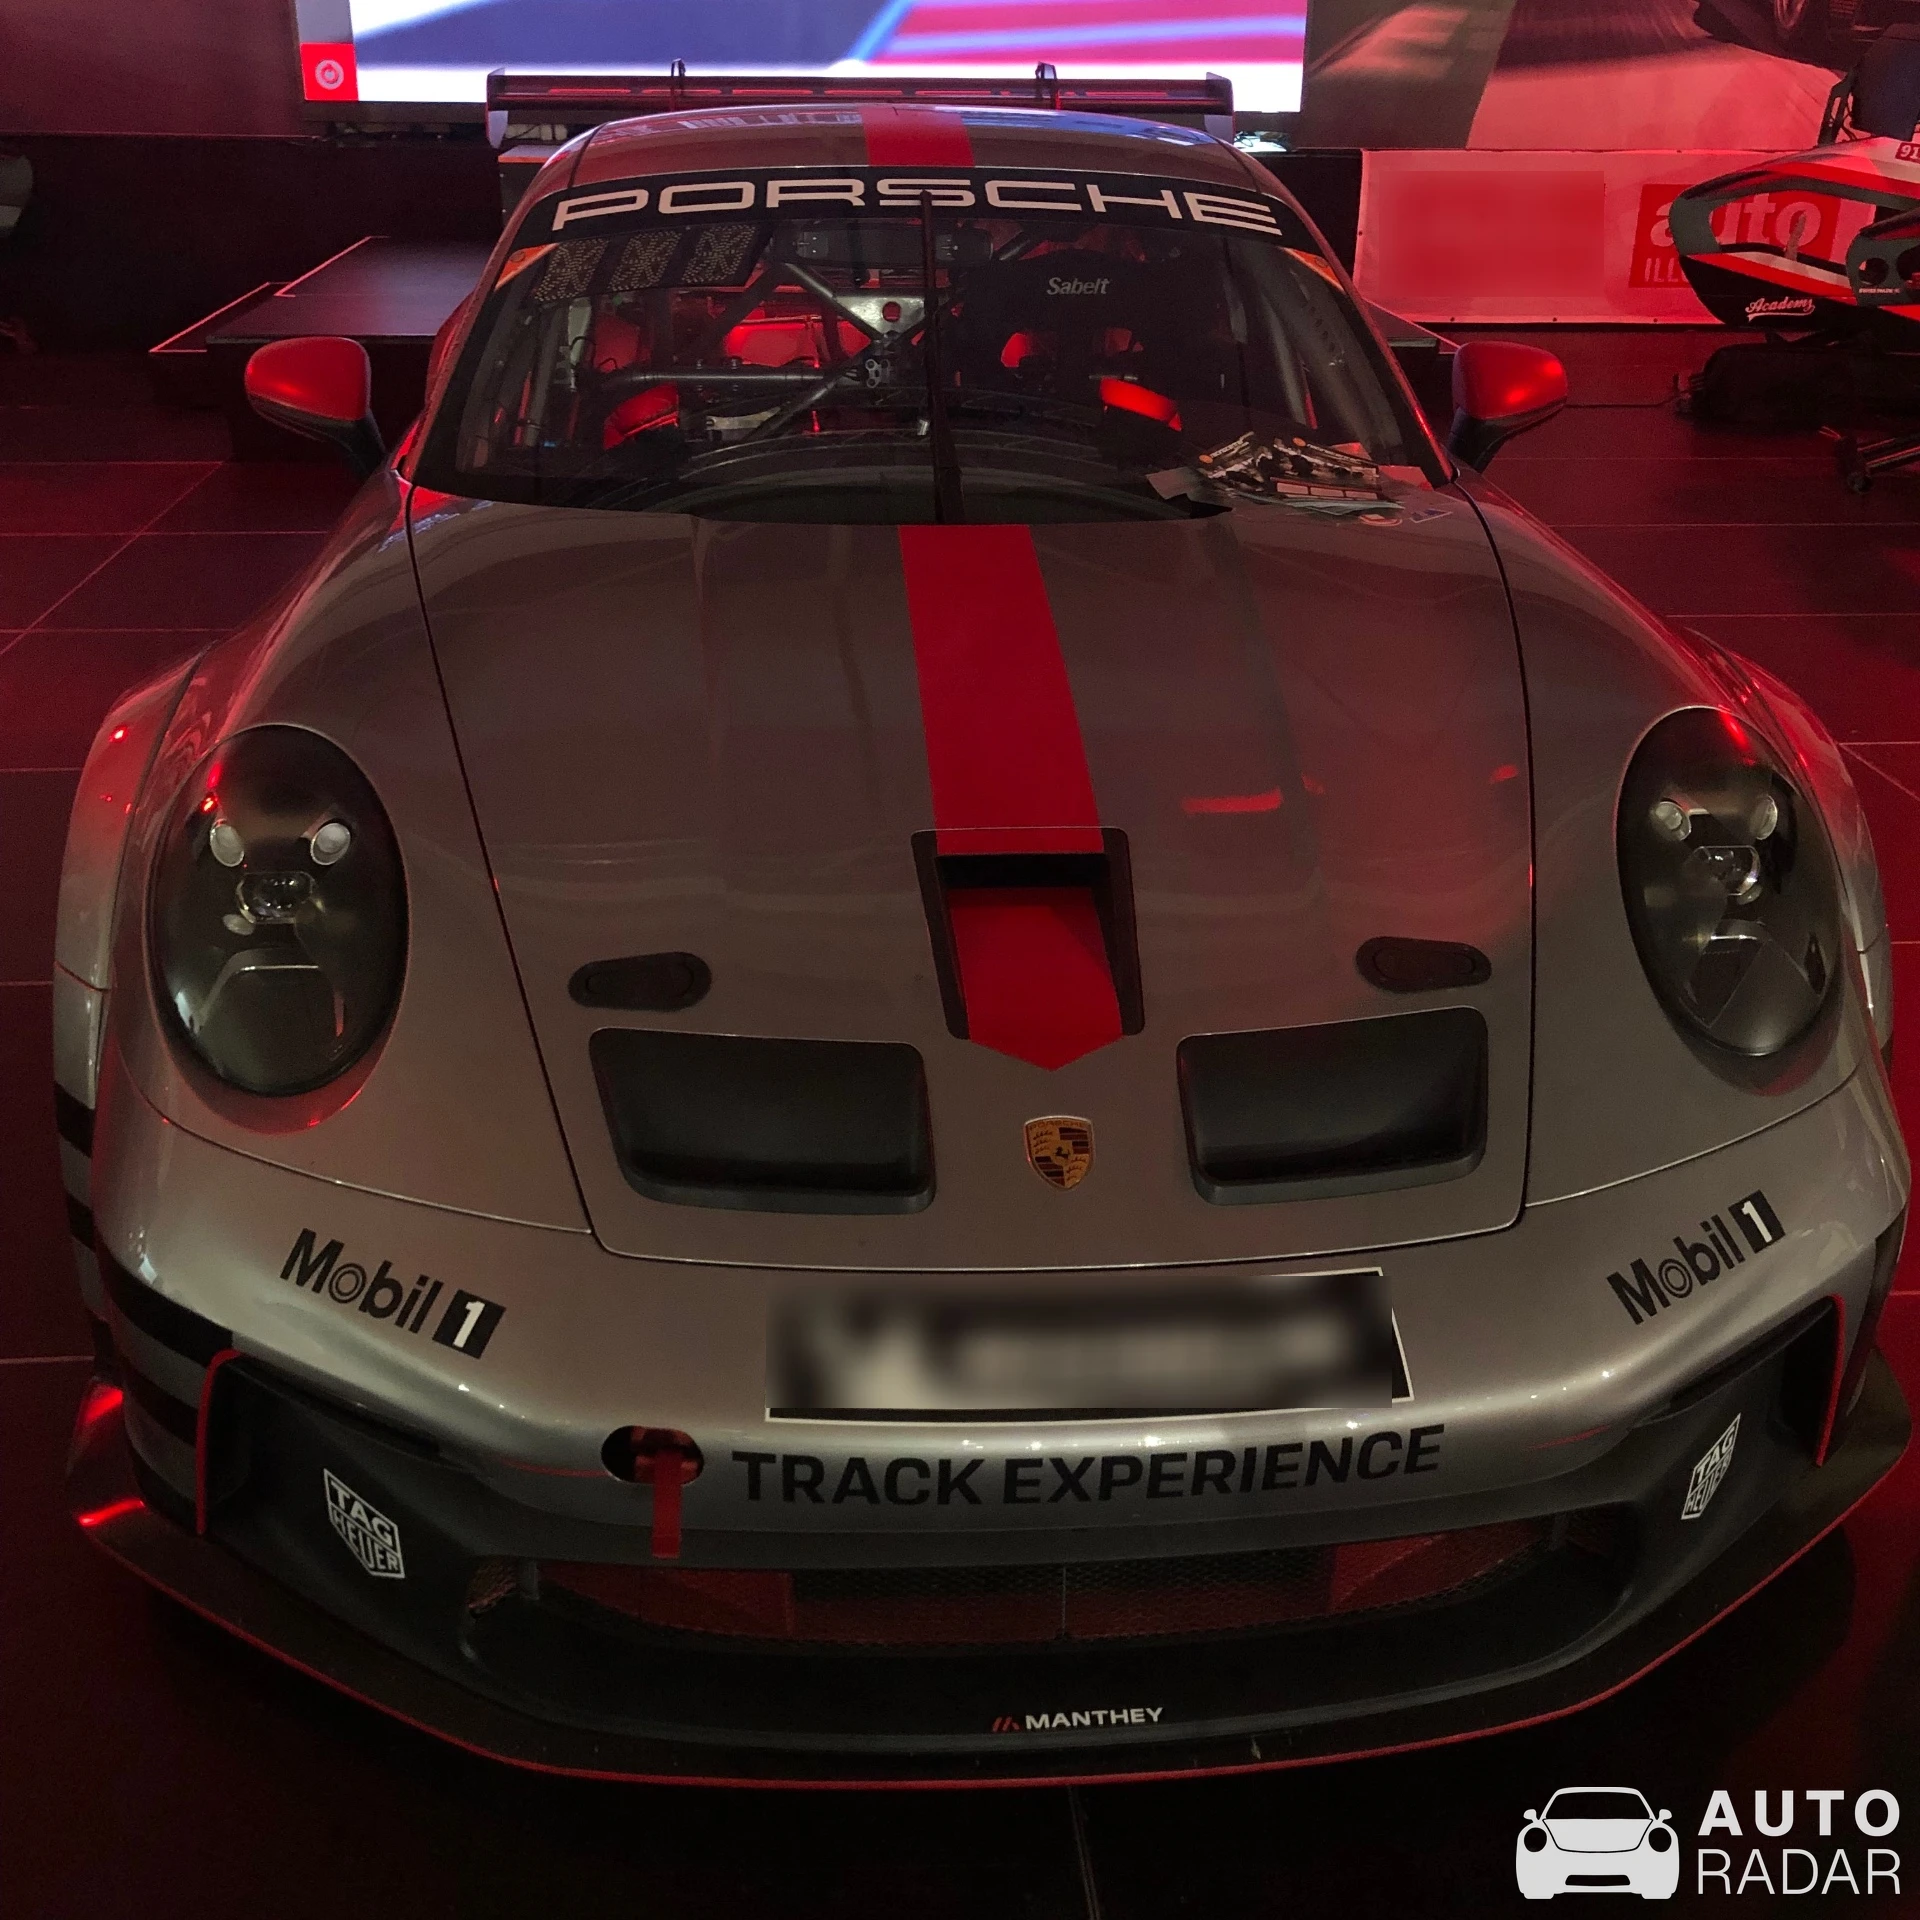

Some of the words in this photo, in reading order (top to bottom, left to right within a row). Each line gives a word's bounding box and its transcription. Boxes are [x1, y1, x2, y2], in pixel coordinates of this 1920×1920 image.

[552, 178, 1282, 236] PORSCHE
[1046, 277, 1110, 295] Sabelt
[1745, 296, 1815, 321] Academy
[280, 1228, 444, 1334] Mobil
[1607, 1214, 1745, 1325] Mobil
[732, 1451, 985, 1505] TRACK
[1003, 1424, 1445, 1504] EXPERIENCE
[1697, 1426, 1735, 1485] TAG
[331, 1480, 393, 1547] TAG
[333, 1508, 398, 1570] HEUER
[1025, 1707, 1163, 1730] MANTHEY
